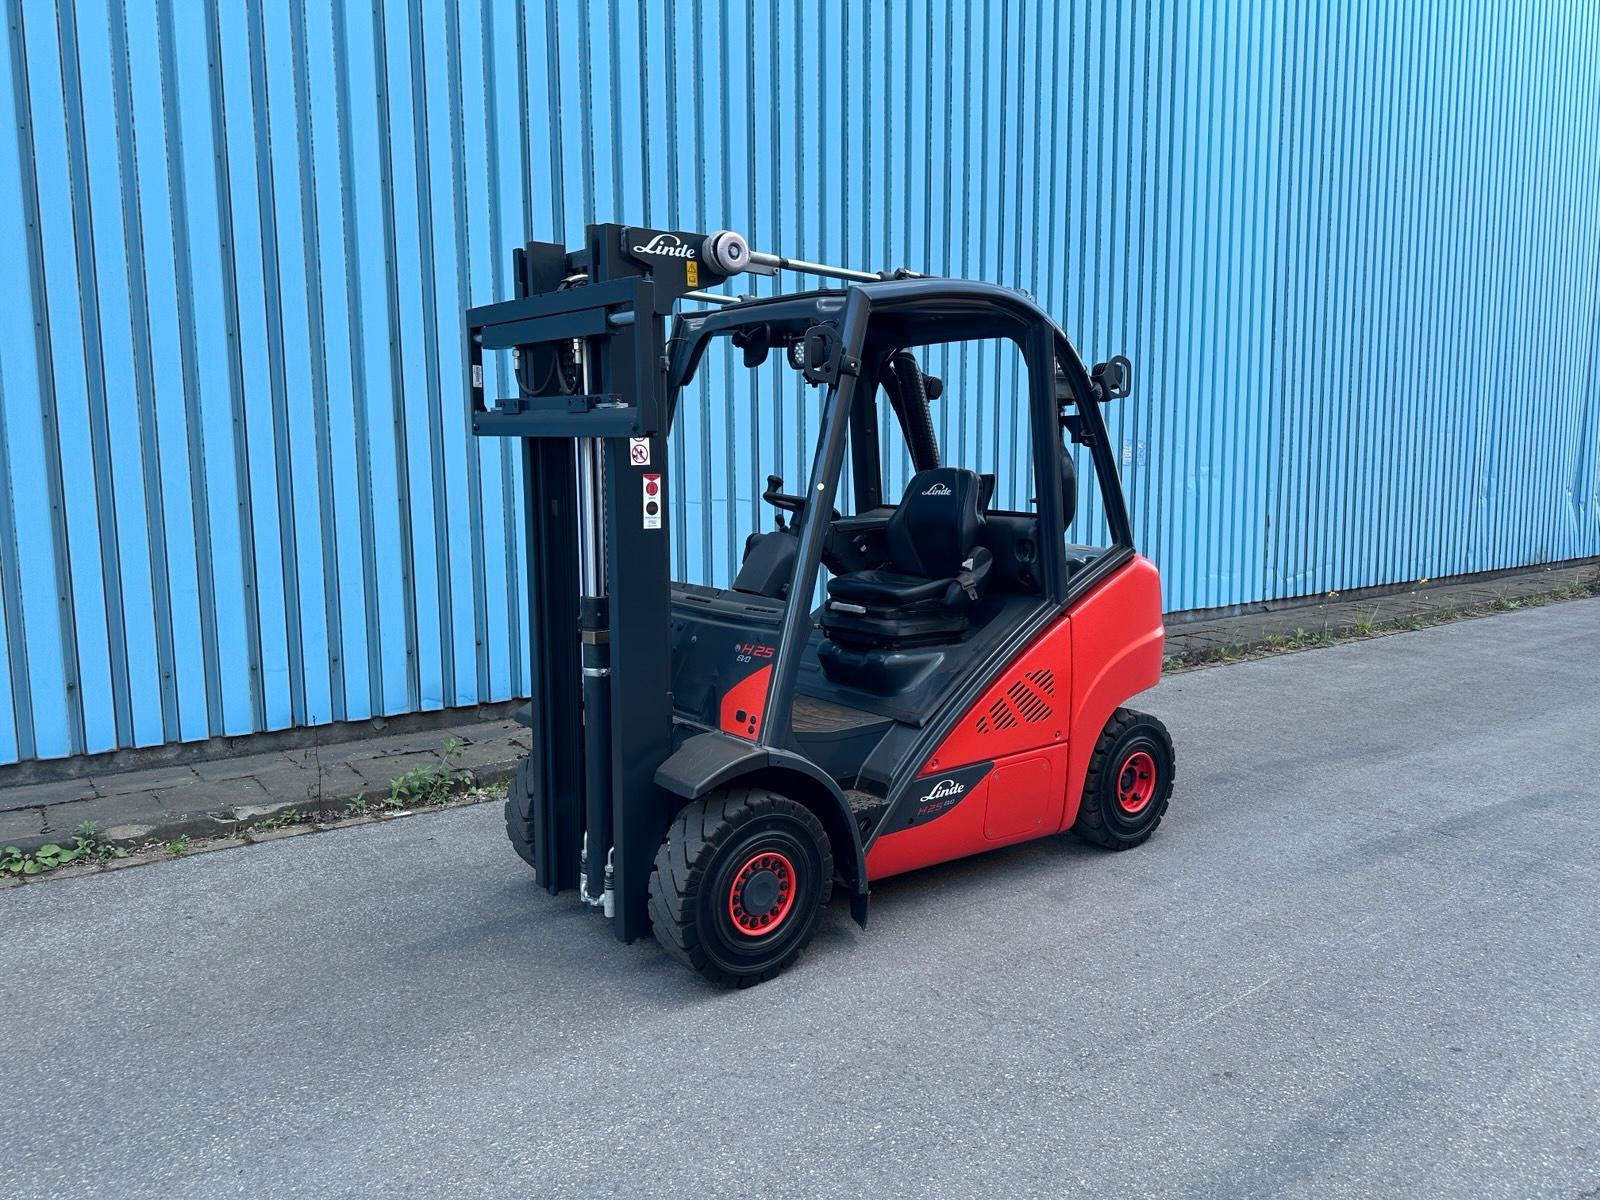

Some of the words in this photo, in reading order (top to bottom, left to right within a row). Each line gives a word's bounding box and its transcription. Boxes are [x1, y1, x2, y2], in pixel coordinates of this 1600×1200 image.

[633, 233, 696, 259] Linde
[921, 482, 952, 496] Linde
[920, 779, 965, 802] Linde
